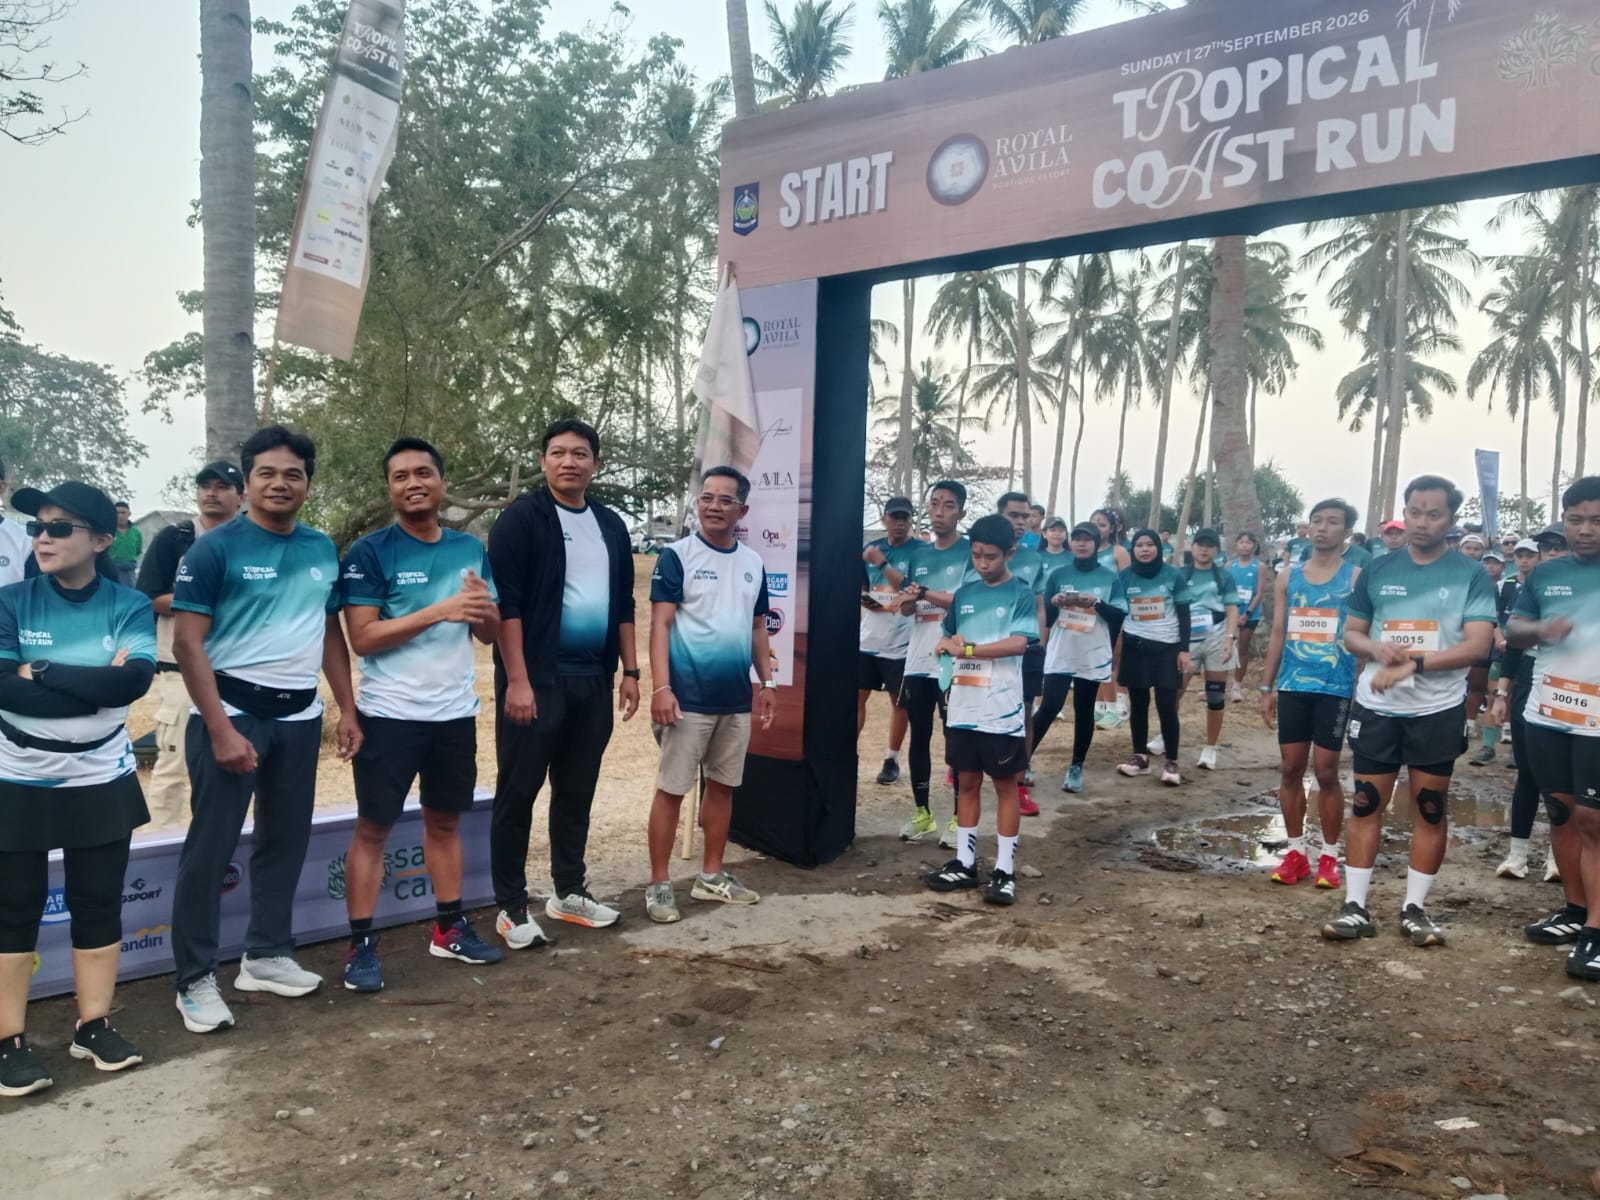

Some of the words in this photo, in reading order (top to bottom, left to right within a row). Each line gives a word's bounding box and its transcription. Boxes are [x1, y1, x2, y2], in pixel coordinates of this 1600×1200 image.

[1120, 51, 1182, 77] SUNDAY
[1326, 9, 1370, 32] 2026
[1112, 28, 1439, 142] TROPICAL
[995, 125, 1073, 157] ROYAL
[993, 146, 1069, 178] AVILA
[1091, 126, 1295, 210] COAST
[1314, 97, 1457, 173] RUN
[778, 151, 894, 229] START
[763, 316, 801, 332] ROYAL
[762, 329, 800, 344] AVILA
[762, 529, 780, 543] Opa
[765, 615, 780, 629] Cleo
[1299, 620, 1328, 628] 30010
[1390, 635, 1424, 644] 30015
[1552, 692, 1588, 708] 30016
[394, 844, 426, 869] sa
[394, 876, 436, 900] ca
[120, 935, 163, 953] andiri
